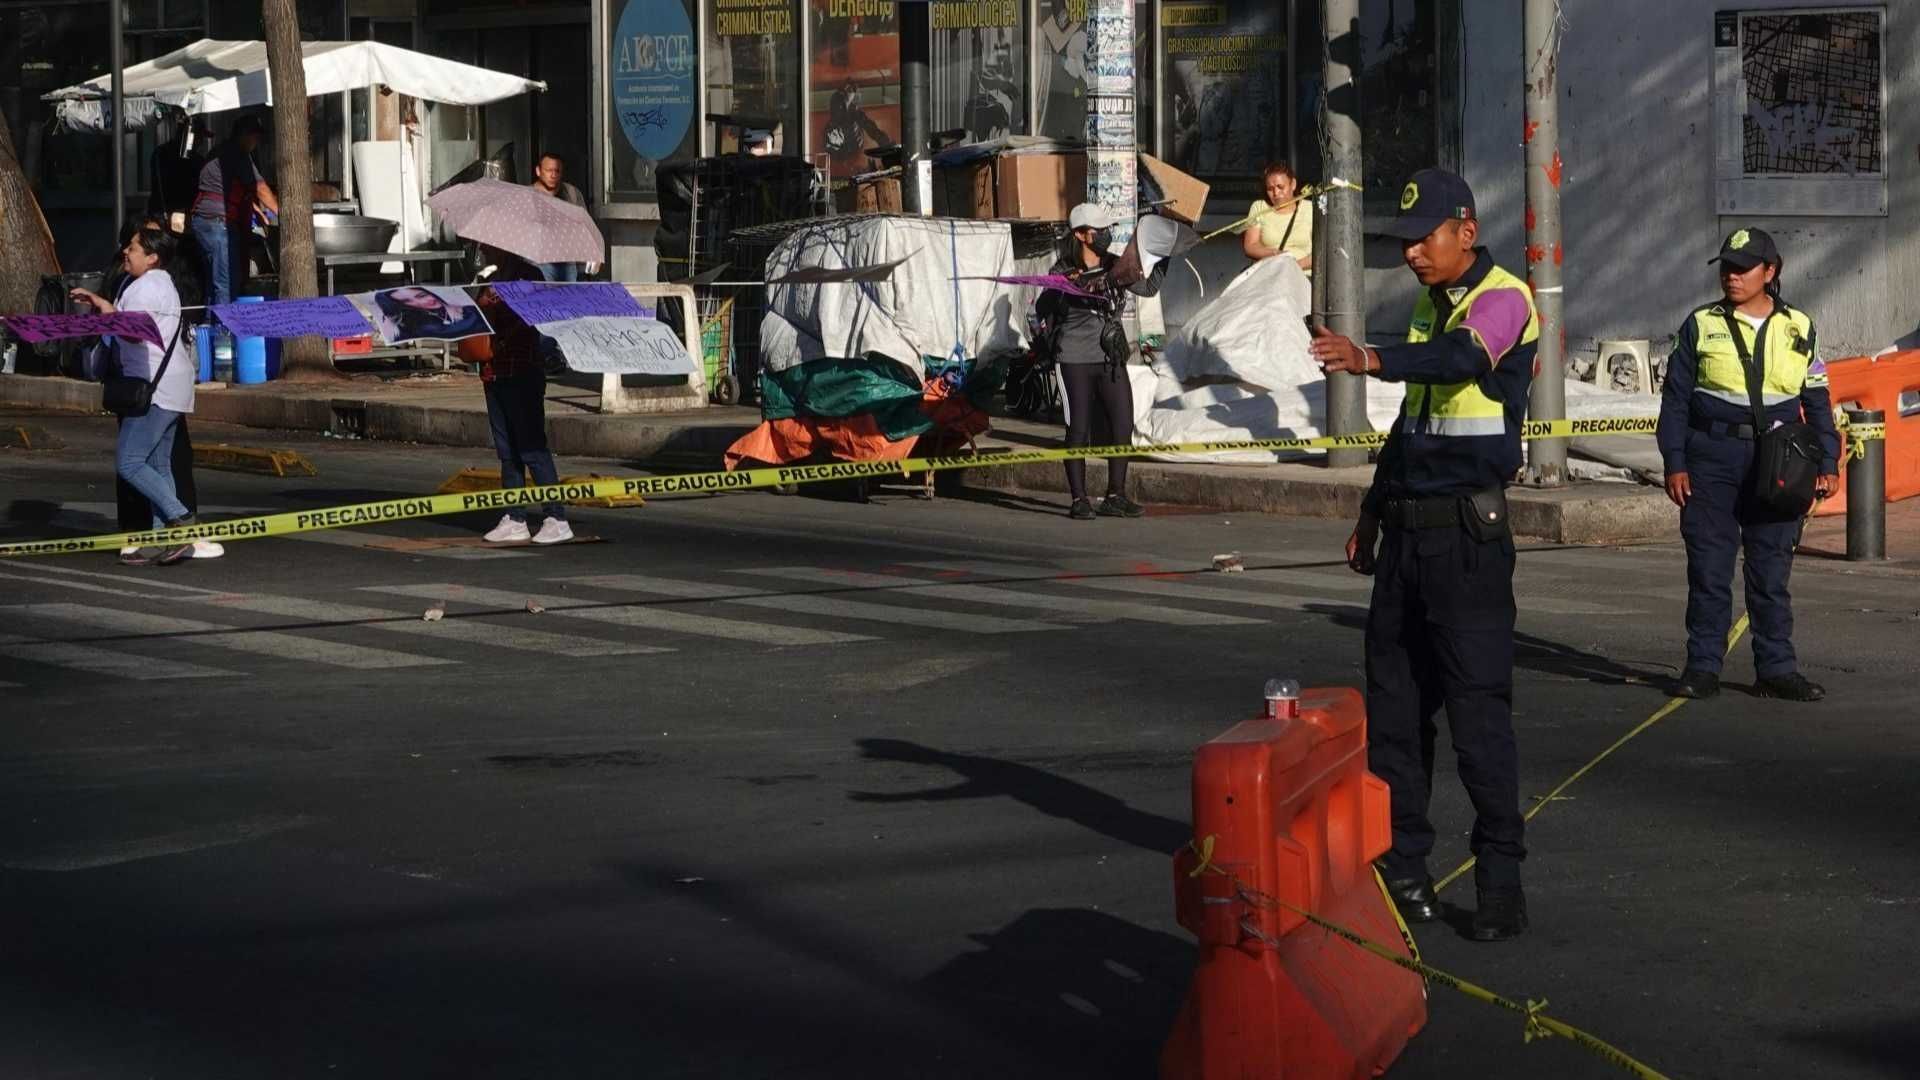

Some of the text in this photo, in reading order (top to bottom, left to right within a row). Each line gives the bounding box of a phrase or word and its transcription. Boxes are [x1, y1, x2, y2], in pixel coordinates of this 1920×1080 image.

[127, 519, 267, 545] PRECAUCIÓN
[297, 499, 433, 528] PRECAUCIÓN
[462, 484, 595, 509] PRECAUCIÓN
[624, 471, 752, 495] PRECAUCIÓN
[779, 459, 902, 482] PRECAUCIÓN
